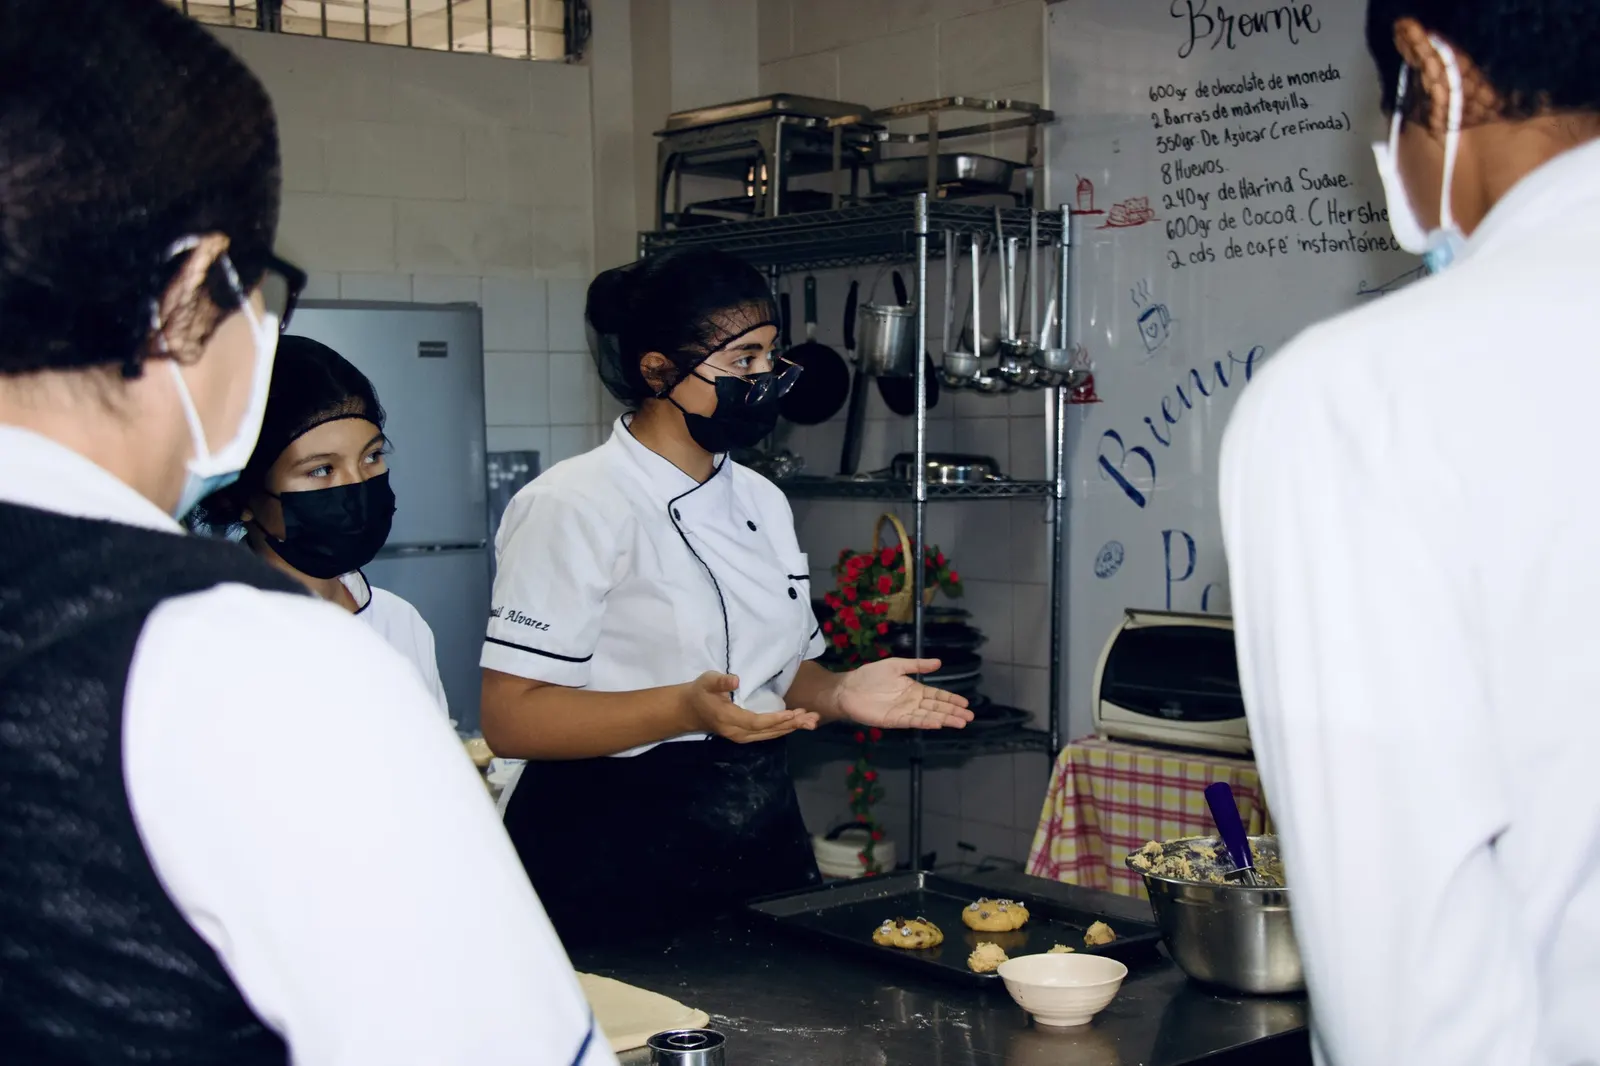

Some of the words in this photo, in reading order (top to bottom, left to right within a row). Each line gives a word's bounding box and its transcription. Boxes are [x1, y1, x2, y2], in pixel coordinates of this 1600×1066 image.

[1170, 0, 1321, 58] Brownie
[1149, 84, 1188, 102] 600gr
[1195, 80, 1209, 98] de
[1212, 71, 1265, 97] chocolate
[1268, 73, 1283, 91] de
[1287, 63, 1341, 86] moneda
[1151, 112, 1163, 129] 2
[1213, 102, 1228, 120] de
[1231, 92, 1309, 117] mantequilla
[1200, 129, 1220, 147] De
[1161, 163, 1172, 185] 8
[1162, 188, 1211, 210] 240gr
[1218, 182, 1238, 201] de
[1239, 177, 1294, 200] Harina
[1166, 215, 1212, 240] 600gr
[1218, 212, 1238, 231] de
[1167, 249, 1187, 269] 2
[1189, 241, 1216, 264] cds
[1225, 236, 1243, 259] de
[505, 609, 551, 632] Alvarez
